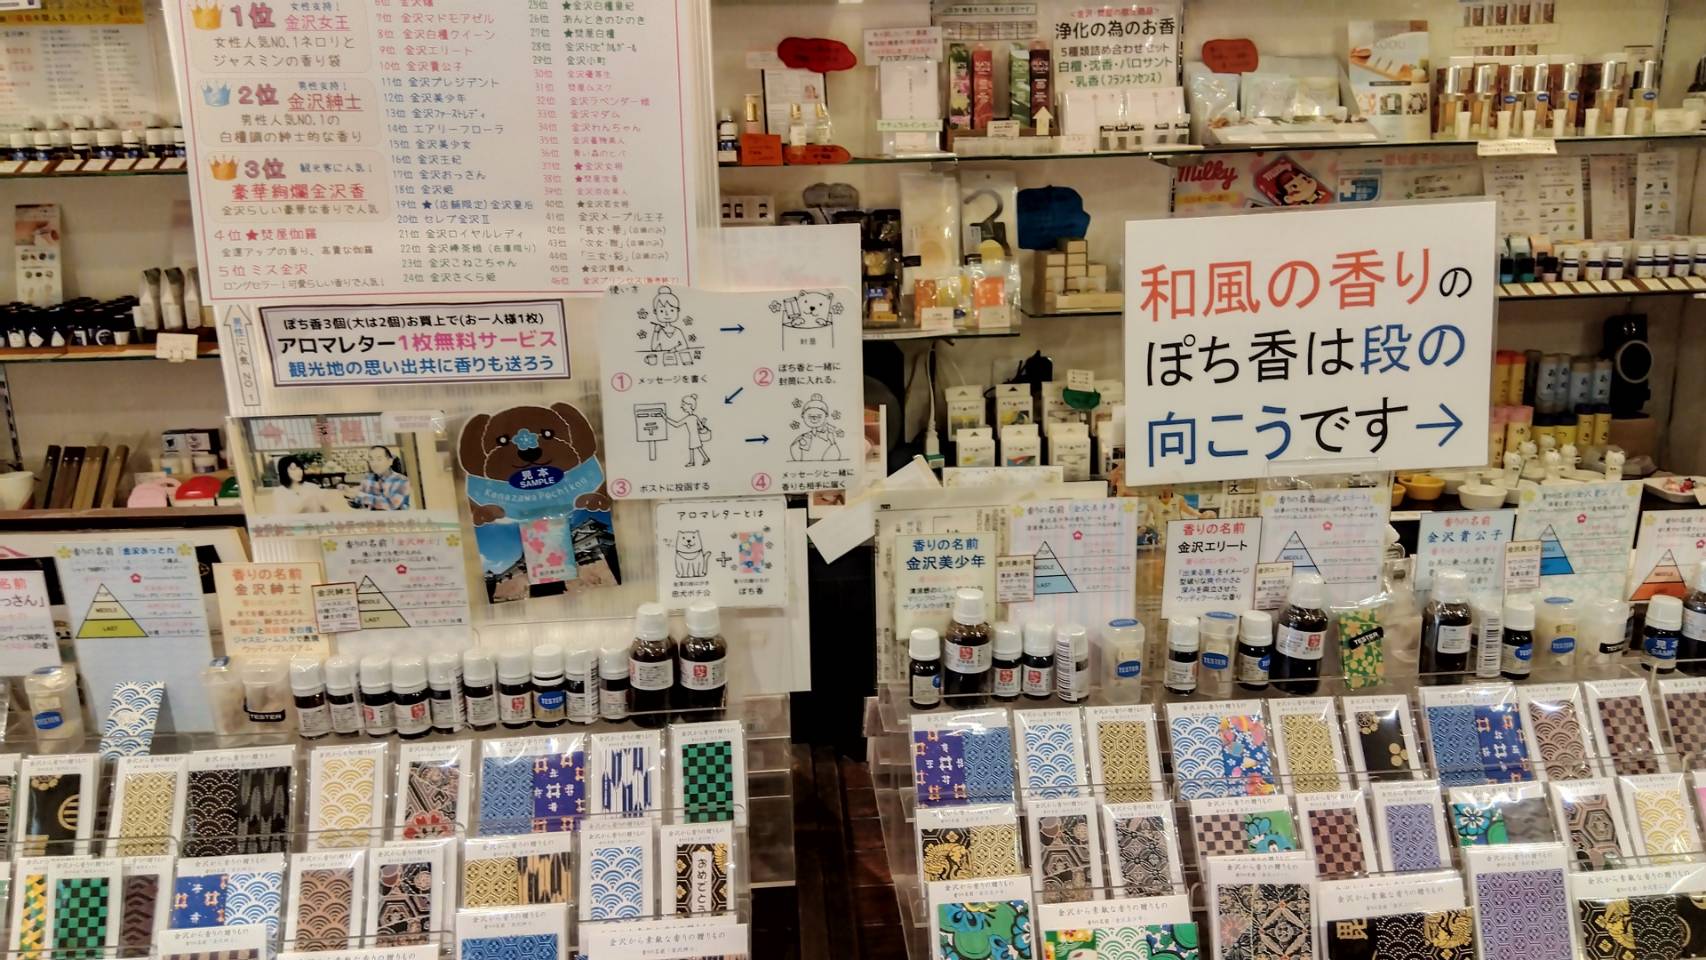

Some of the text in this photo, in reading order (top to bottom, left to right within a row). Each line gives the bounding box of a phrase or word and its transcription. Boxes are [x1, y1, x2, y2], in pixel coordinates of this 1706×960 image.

[230, 3, 276, 29] 1位
[286, 14, 350, 31] 金沢女王
[1055, 17, 1175, 40] 浄化の為のお香
[382, 78, 402, 87] 11位
[238, 84, 279, 105] 2位
[384, 93, 404, 103] 12位
[288, 94, 362, 111] 金沢紳士
[390, 140, 409, 149] 15位
[244, 158, 286, 180] 3位
[1177, 159, 1238, 190] Milky
[214, 229, 241, 241] 4位
[218, 263, 308, 276] 5位 ミス金沢
[1140, 248, 1473, 322] 和風の香りの
[278, 330, 557, 354] アロマレター1枚無料サービス
[1146, 323, 1466, 387] ぽち香は段の
[289, 356, 554, 378] 観光地の思い出共に香りも送ろう
[1147, 397, 1409, 467] 向こうです
[521, 467, 549, 481] 見本
[519, 477, 556, 489] SAMPLE
[677, 510, 765, 521] アロマレターとは
[1184, 523, 1246, 535] 香りの名前
[1428, 529, 1503, 543] 金沢貴公子
[913, 538, 979, 552] 香りの名前
[1178, 541, 1248, 554] 金沢エリート
[906, 555, 986, 571] 金沢美少年
[232, 568, 302, 580] 香りの名前
[234, 583, 302, 596] 金沢紳士
[1353, 630, 1381, 647] TESTER
[250, 712, 282, 720] TESTER
